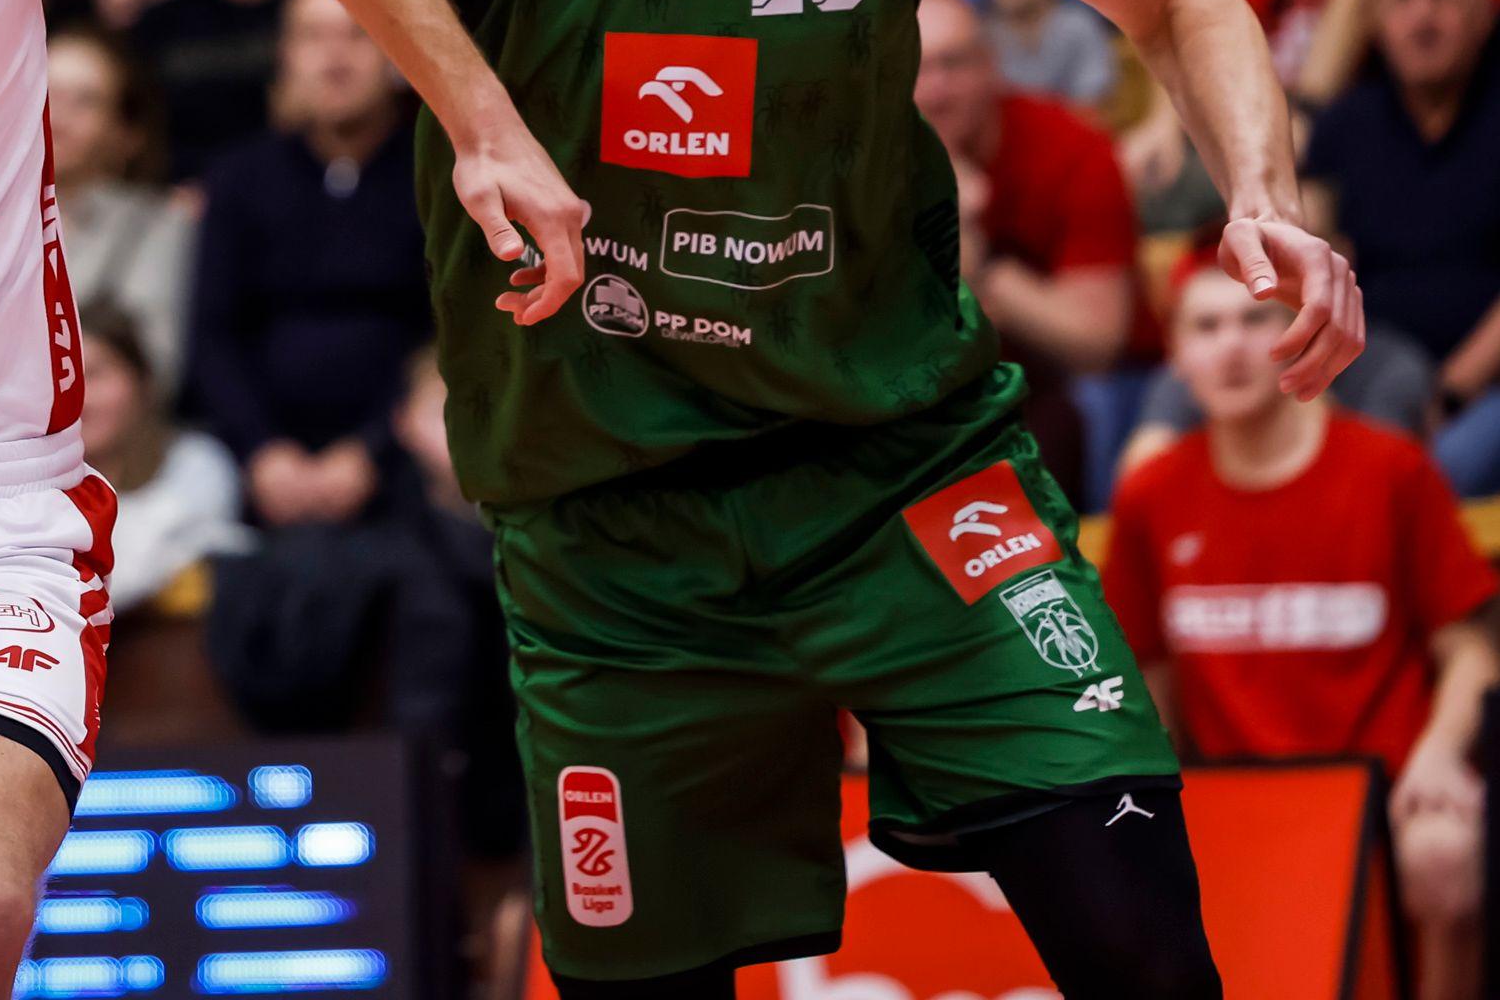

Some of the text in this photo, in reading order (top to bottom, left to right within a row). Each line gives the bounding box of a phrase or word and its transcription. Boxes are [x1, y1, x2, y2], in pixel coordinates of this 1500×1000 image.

[623, 129, 731, 156] ORLEN
[673, 230, 824, 264] PIB NOWUM
[655, 310, 751, 345] PP DOM
[964, 532, 1042, 578] ORLEN
[1073, 675, 1124, 712] 4F
[564, 790, 613, 804] ORLEN
[571, 882, 623, 896] Basket
[582, 898, 615, 914] Liga
